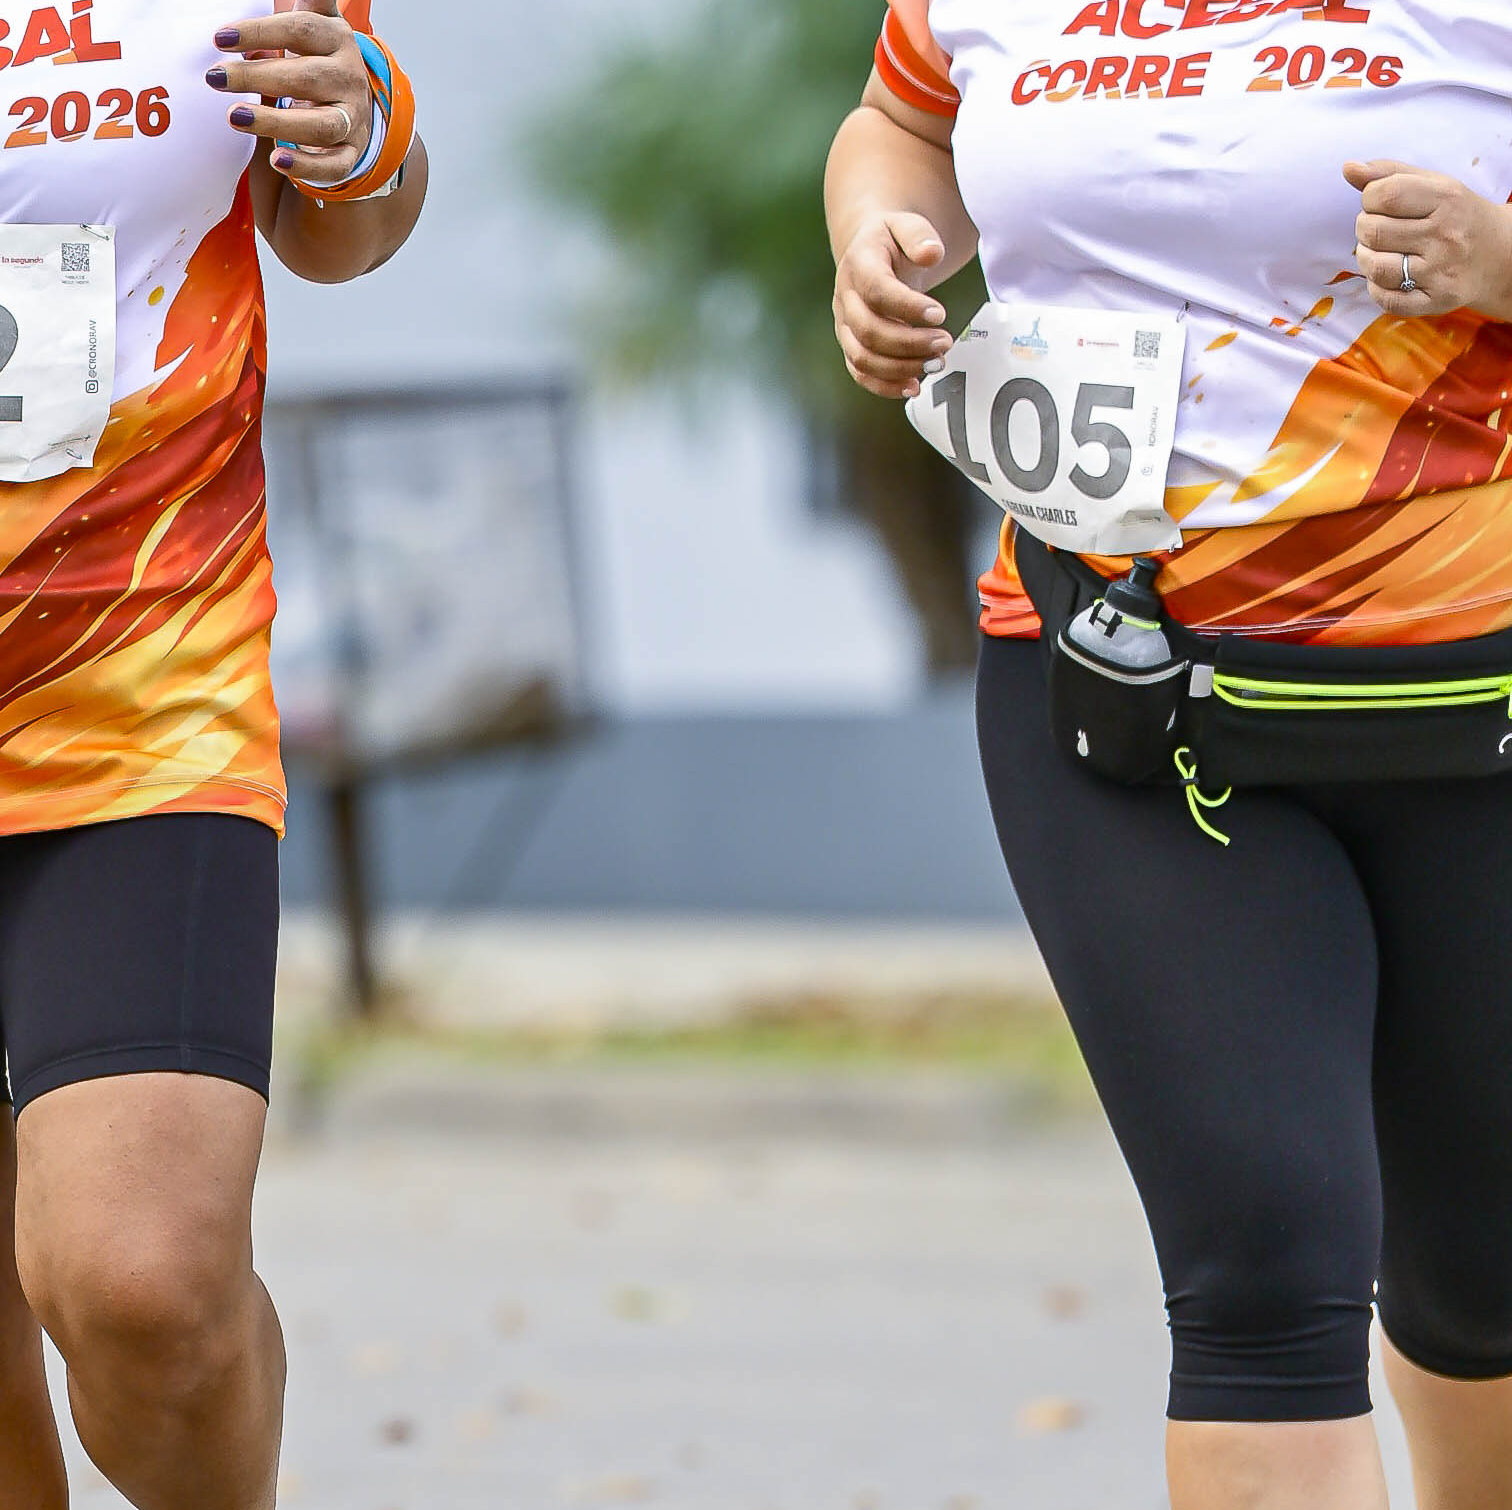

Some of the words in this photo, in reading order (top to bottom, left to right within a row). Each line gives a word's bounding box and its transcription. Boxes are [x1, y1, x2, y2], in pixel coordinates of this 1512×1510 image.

[1011, 51, 1212, 106] CORRE
[1245, 44, 1405, 93] 2026
[4, 85, 171, 149] 2026
[931, 371, 1135, 500] 105
